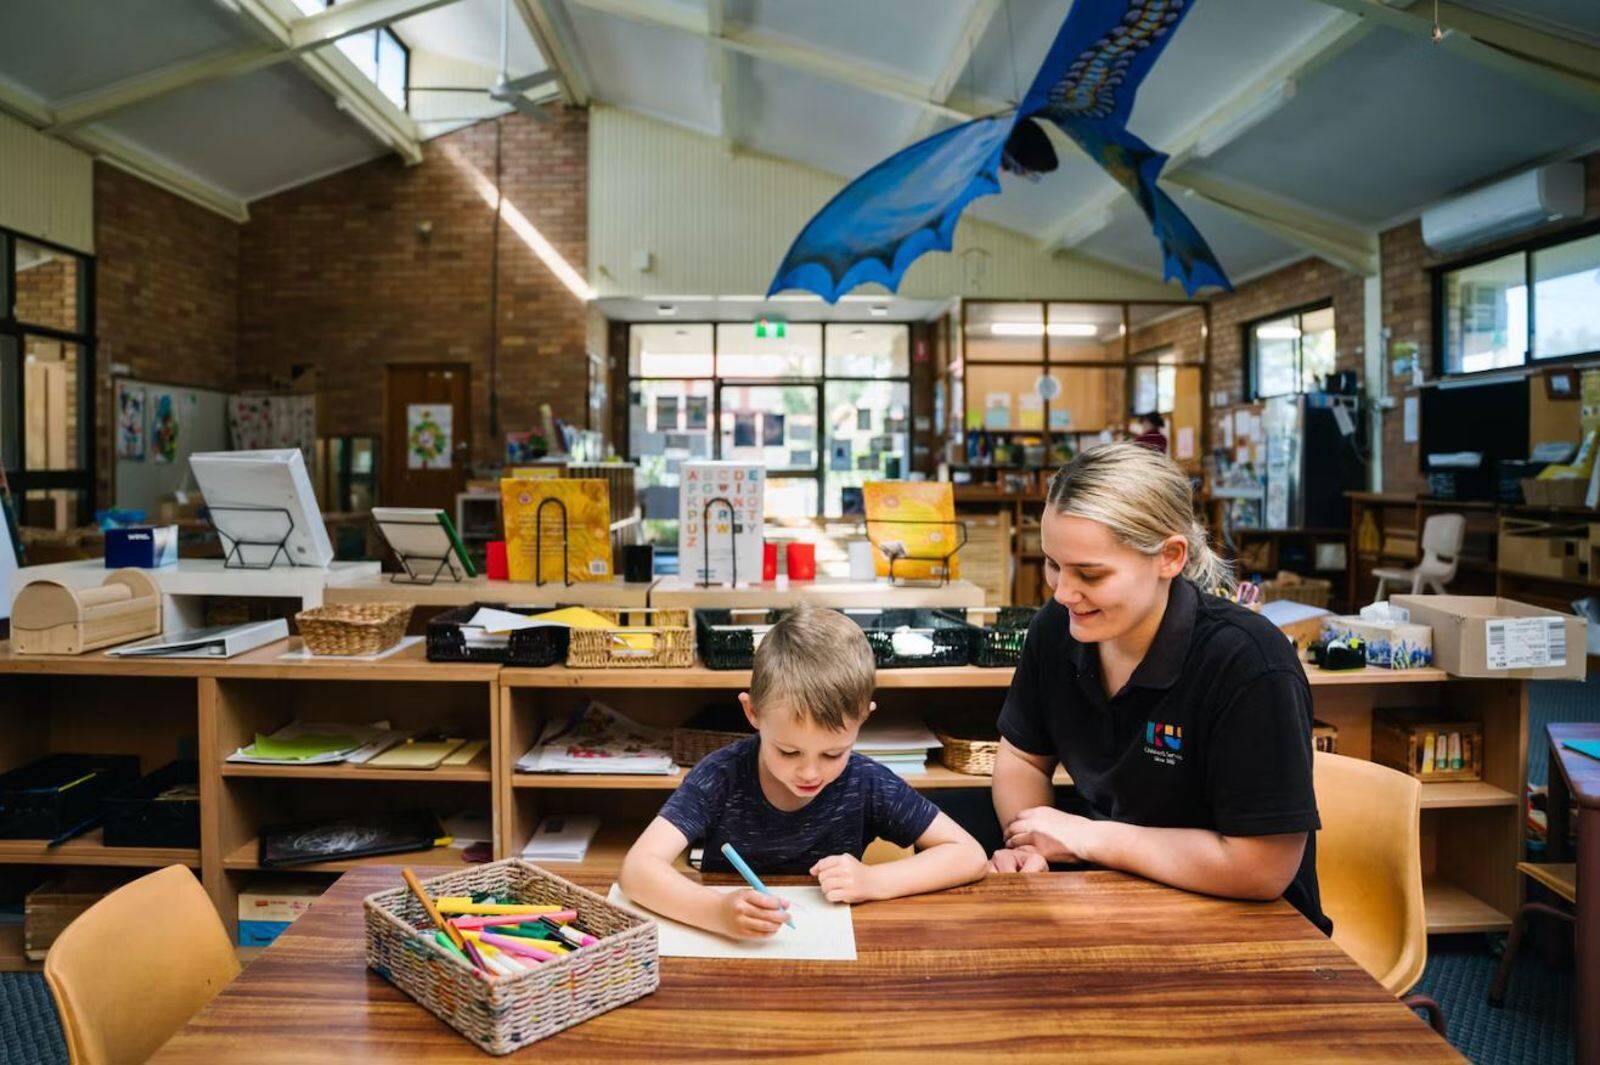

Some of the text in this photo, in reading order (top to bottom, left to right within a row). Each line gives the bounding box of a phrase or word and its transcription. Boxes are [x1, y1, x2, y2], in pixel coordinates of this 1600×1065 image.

[688, 467, 697, 481] A
[734, 469, 744, 481] D
[749, 469, 759, 481] E
[1146, 720, 1183, 751] KU
